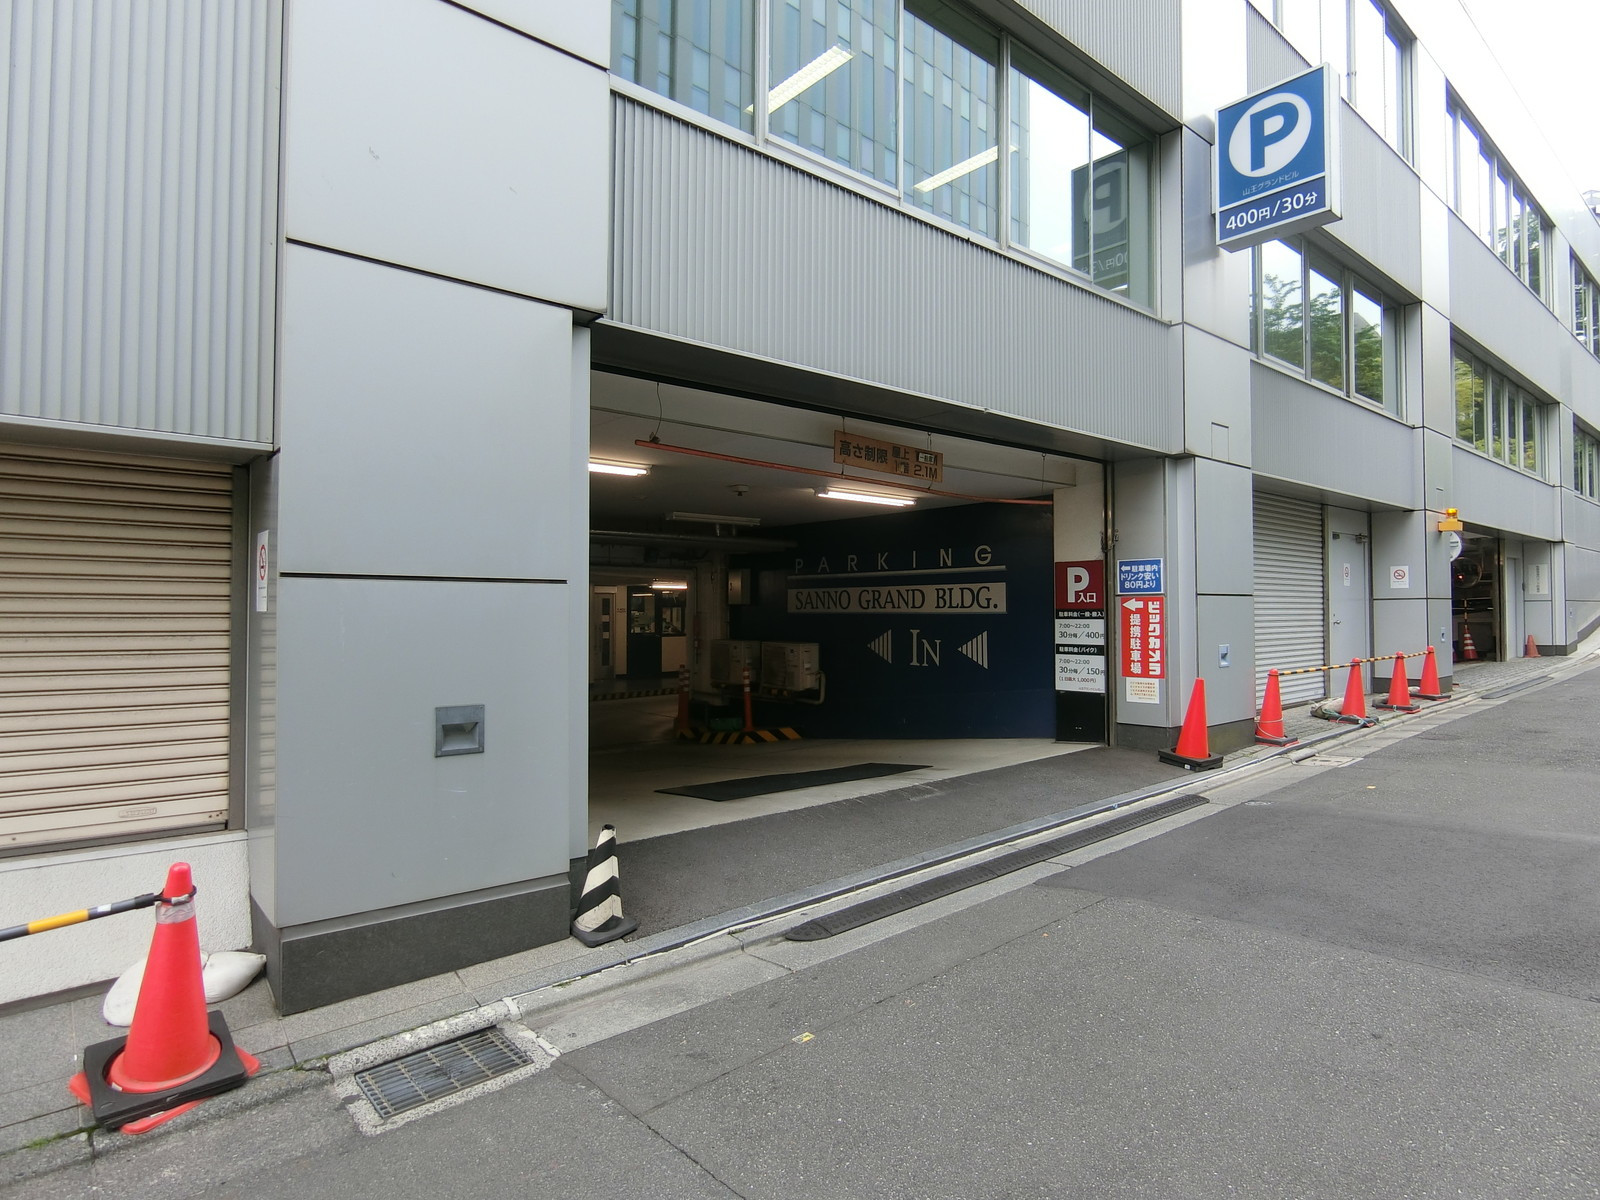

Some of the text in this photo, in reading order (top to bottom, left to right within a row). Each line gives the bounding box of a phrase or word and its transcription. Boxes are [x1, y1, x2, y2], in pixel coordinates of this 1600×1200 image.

[1249, 101, 1299, 173] P
[1242, 171, 1300, 197] 山王グランドビル
[839, 439, 888, 465] 高さ制限
[913, 464, 938, 480] 2.1M
[795, 544, 993, 574] PARKING
[1131, 564, 1159, 573] 駐車場内
[1067, 566, 1097, 603] P 入口
[1120, 572, 1159, 581] ドリンク安い
[1124, 580, 1156, 589] 80円より
[795, 586, 999, 610] SANNO GRAND BLDG.
[1129, 613, 1142, 675] 提携駐車場
[1148, 601, 1161, 675] ビックカメラ
